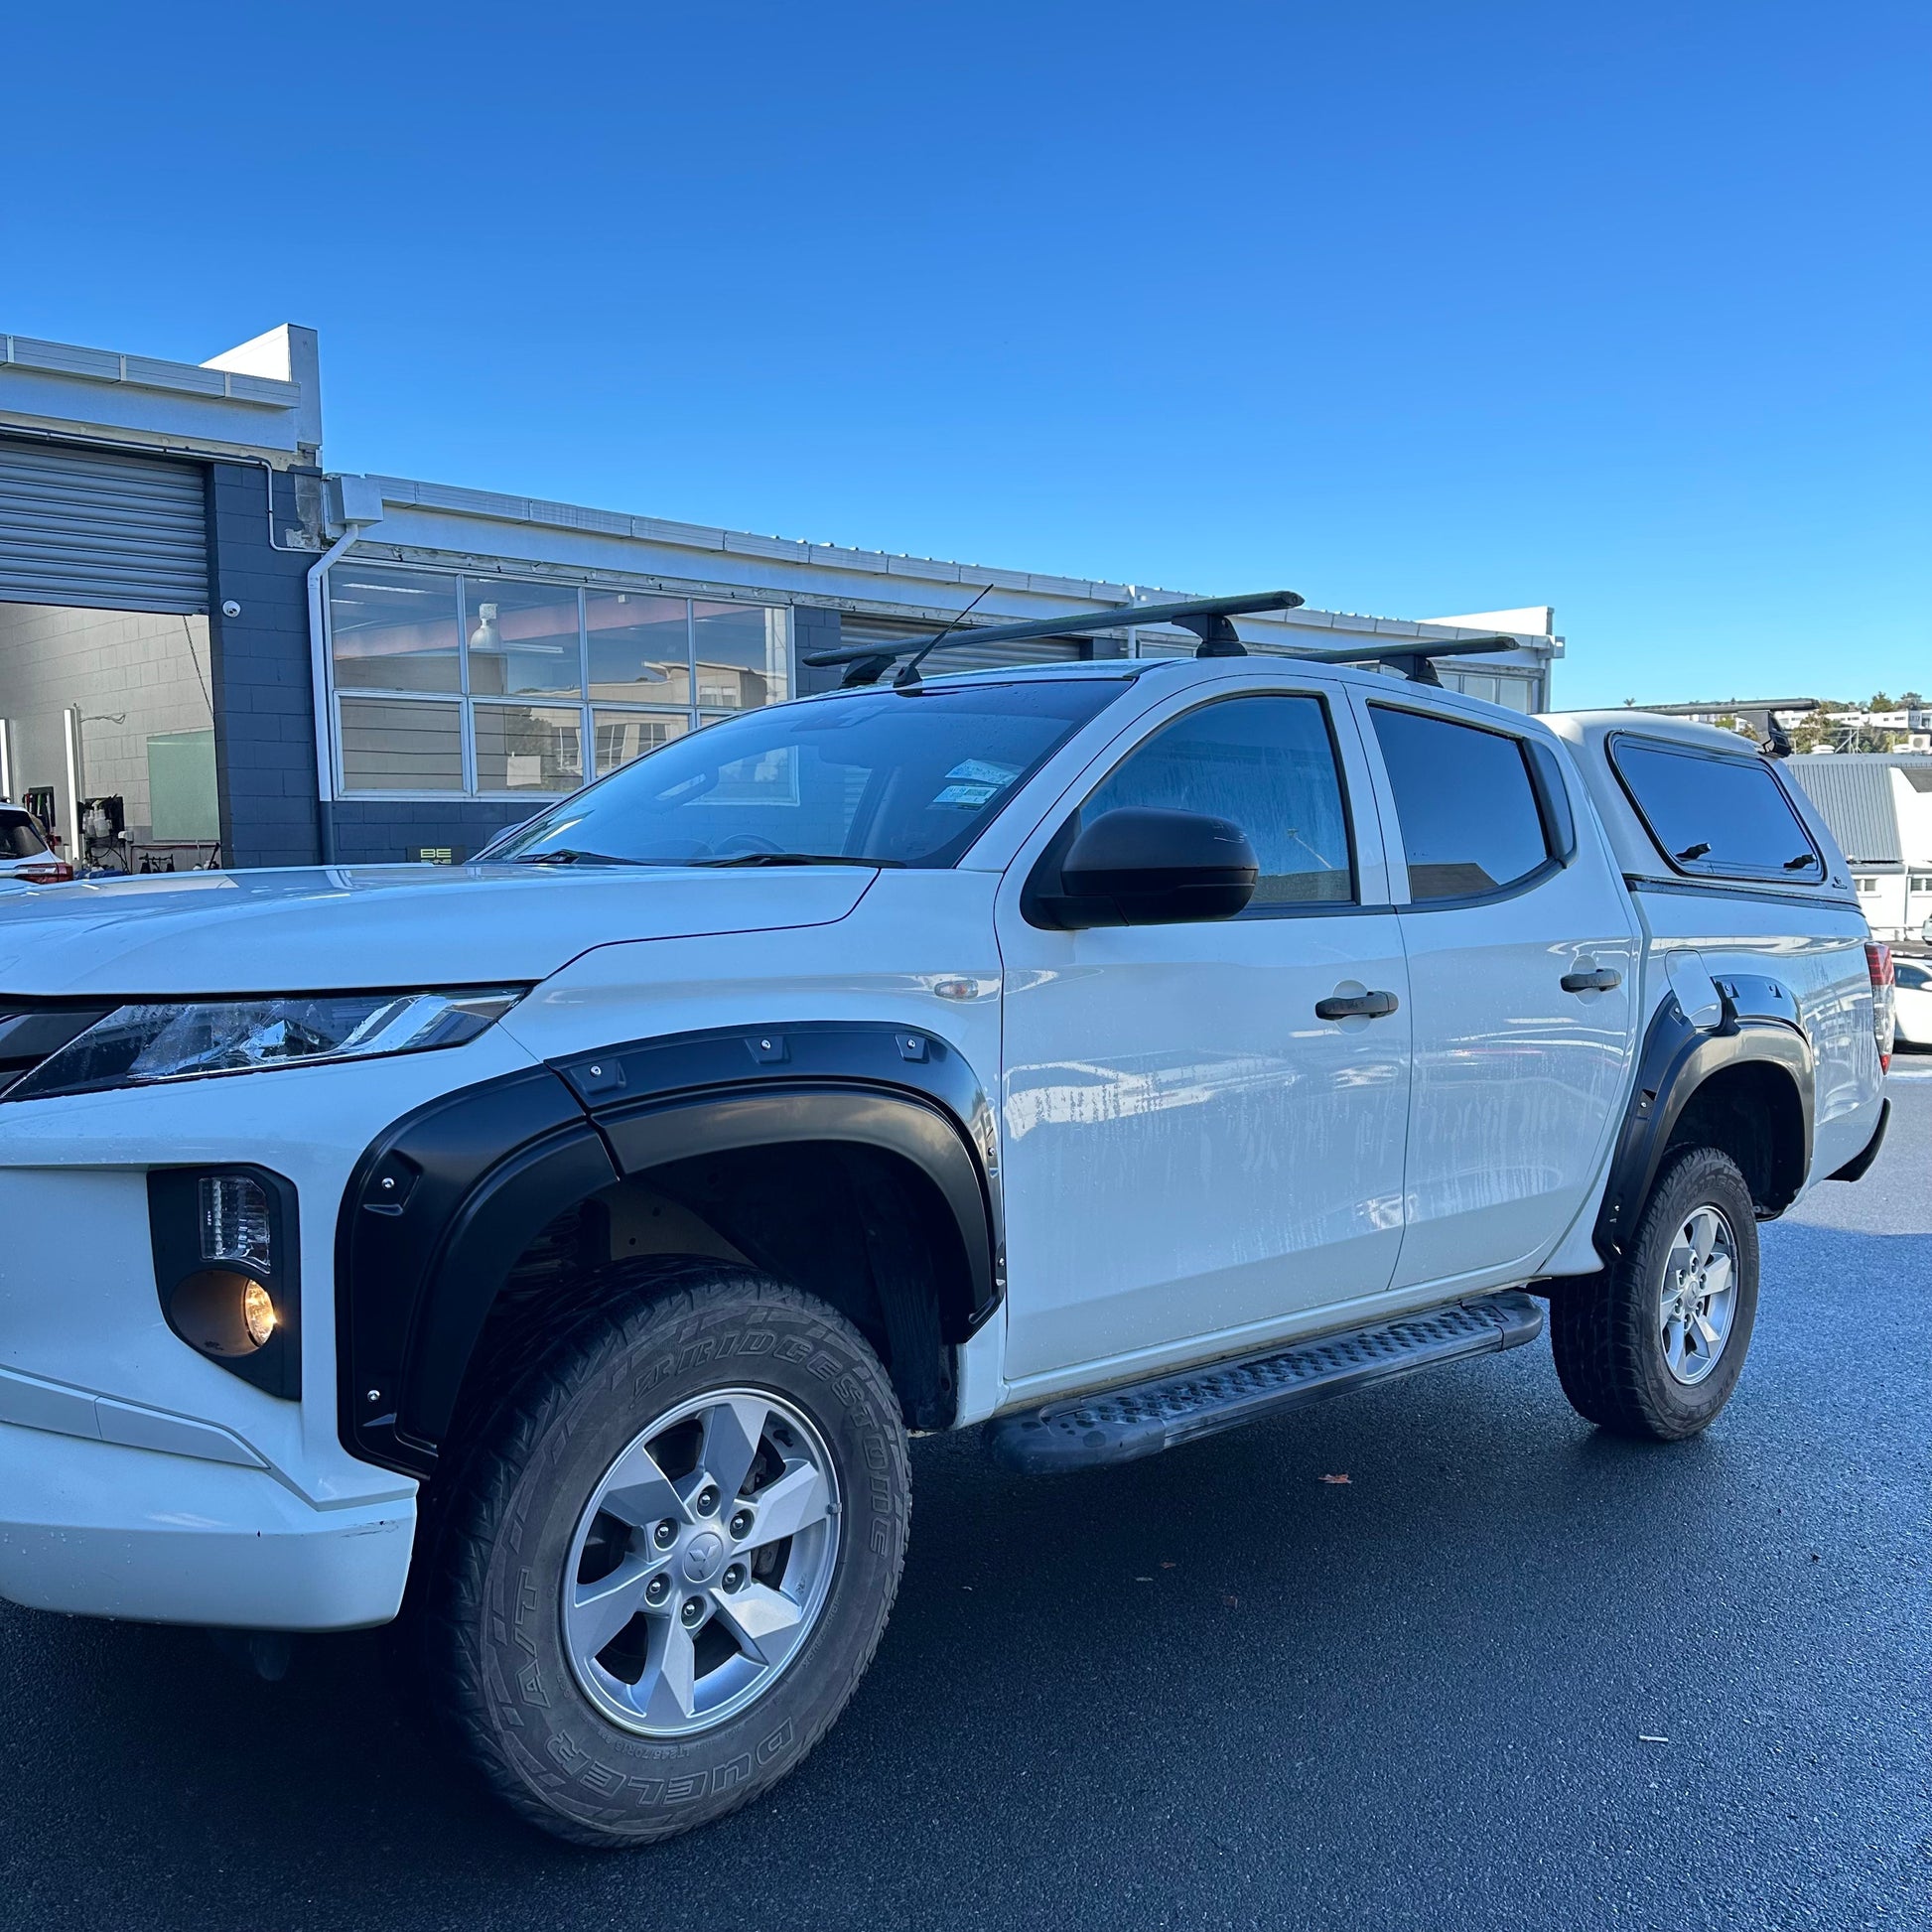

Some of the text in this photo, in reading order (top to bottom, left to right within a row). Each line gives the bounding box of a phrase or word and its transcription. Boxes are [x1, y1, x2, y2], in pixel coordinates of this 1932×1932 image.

[633, 1331, 892, 1557] BRIDGESTONE
[511, 1568, 794, 1807] DUELER A/T
